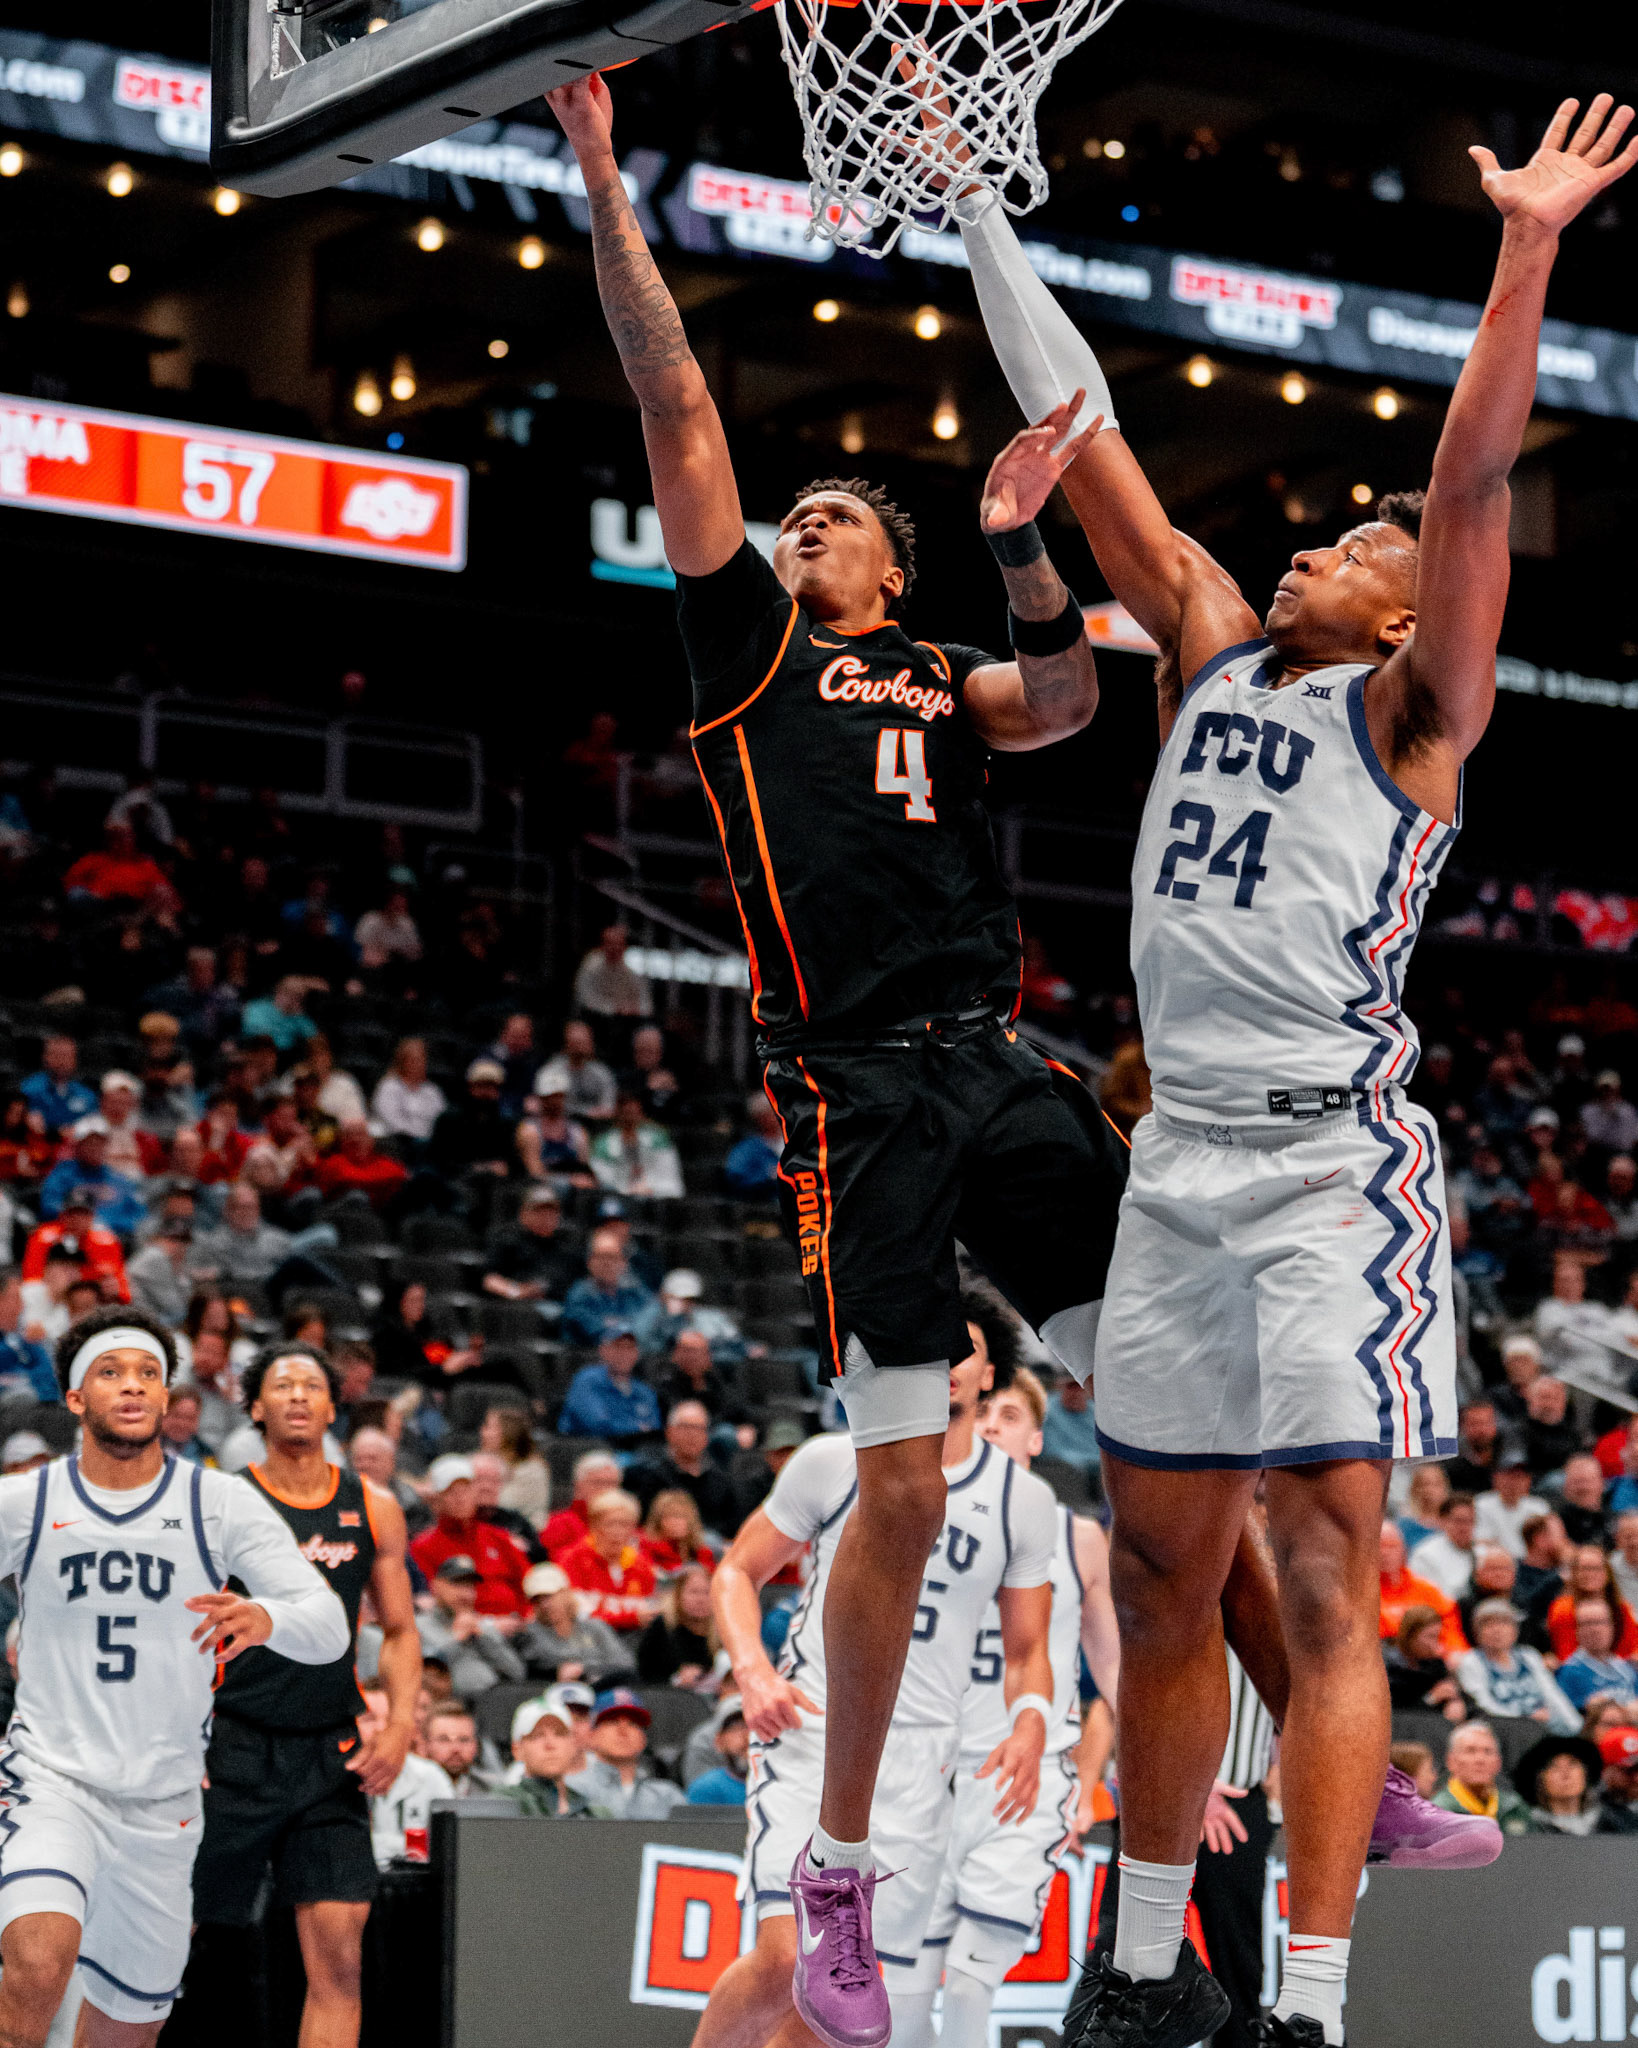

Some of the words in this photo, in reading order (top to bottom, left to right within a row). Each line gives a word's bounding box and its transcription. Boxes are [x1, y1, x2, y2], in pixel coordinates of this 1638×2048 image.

[183, 441, 275, 525] 57
[819, 654, 955, 723] Cowboys
[875, 728, 936, 823] 4
[1180, 711, 1316, 795] TCU
[1153, 799, 1272, 910] 24
[793, 1171, 821, 1276] POKES
[59, 1550, 175, 1604] TCU
[96, 1615, 137, 1683] 5
[1530, 1925, 1638, 2044] di
